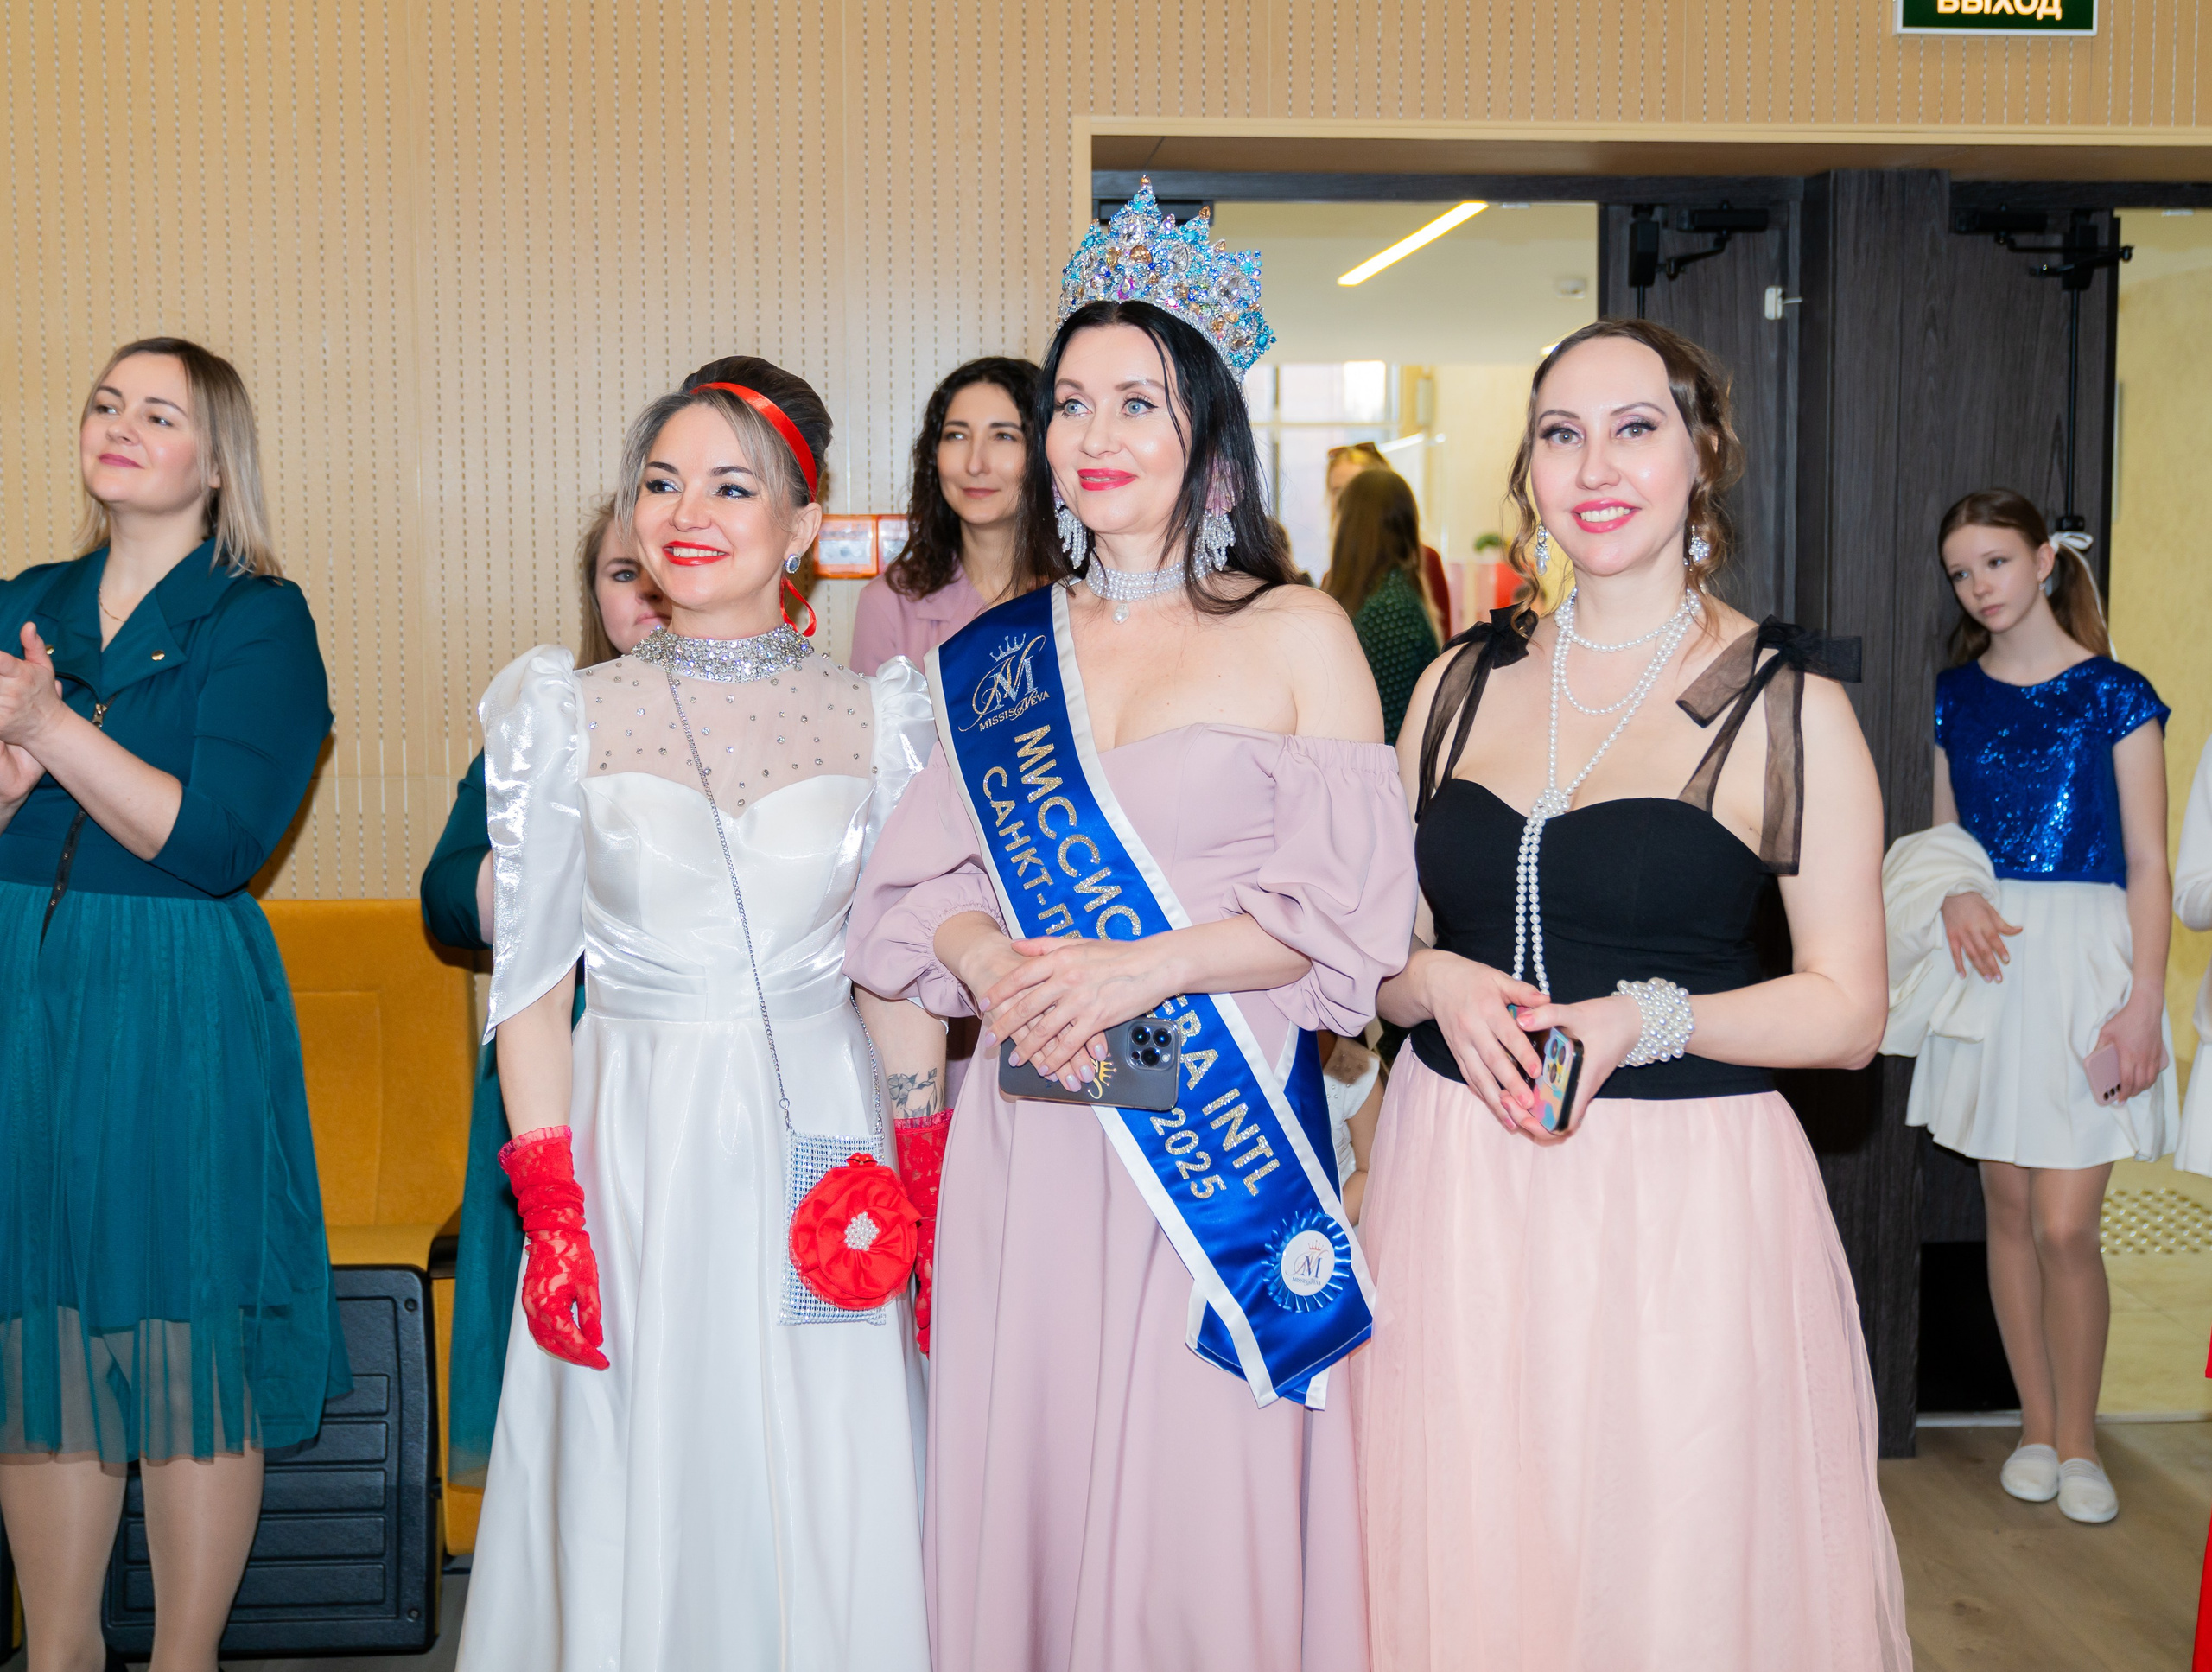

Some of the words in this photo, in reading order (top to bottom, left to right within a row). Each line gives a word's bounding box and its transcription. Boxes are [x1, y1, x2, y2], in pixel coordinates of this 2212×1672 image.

[1014, 724, 1141, 941] МИССИС
[1202, 1088, 1281, 1197] INTL
[1150, 1107, 1227, 1199] 2025
